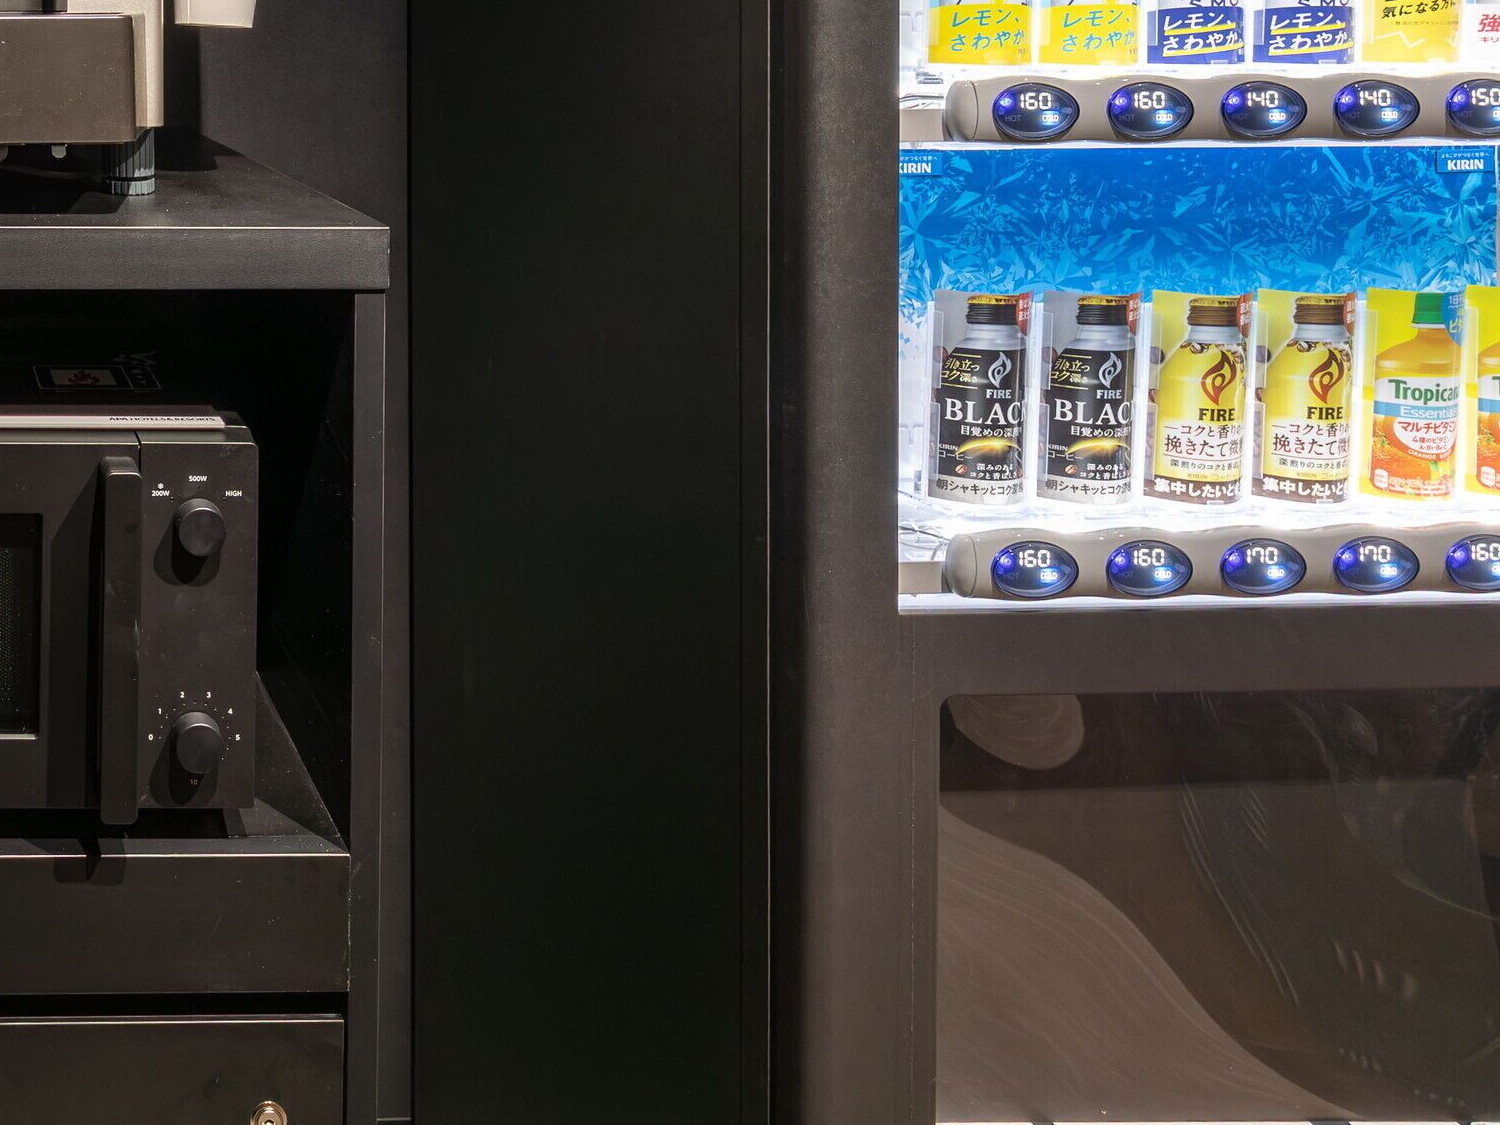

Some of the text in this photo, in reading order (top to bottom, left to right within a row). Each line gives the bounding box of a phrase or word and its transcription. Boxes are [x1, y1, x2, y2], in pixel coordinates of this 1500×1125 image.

[951, 9, 1020, 28] レモン、
[1063, 10, 1130, 28] レモン、
[1163, 12, 1233, 31] レモン、
[1270, 12, 1343, 31] レモン、
[1020, 92, 1052, 110] 160
[1133, 91, 1166, 109] 160
[1247, 90, 1279, 108] 140
[1359, 89, 1391, 107] 140
[1004, 114, 1021, 122] HOT
[1042, 114, 1059, 122] COLD
[1118, 114, 1135, 122] HOT
[1155, 113, 1173, 122] COLD
[1269, 112, 1286, 121] COLD
[1381, 111, 1398, 120] COLD
[1447, 159, 1484, 171] KIRIN
[944, 357, 980, 372] 引き立つ
[1054, 358, 1090, 372] 引き立つ
[985, 389, 1012, 399] FIRE
[1096, 389, 1122, 399] FIRE
[1198, 407, 1236, 422] FIRE
[1307, 406, 1343, 420] FIRE
[939, 443, 959, 451] KIRIN
[1048, 443, 1068, 451] KIRIN
[939, 450, 974, 461] コーヒー
[1048, 450, 1084, 461] コーヒー
[976, 463, 1014, 471] 深みのある
[1086, 463, 1123, 471] 深みのある
[1018, 549, 1051, 568] 160
[1133, 549, 1165, 567] 160
[1246, 546, 1278, 564] 170
[1359, 544, 1391, 563] 170
[1470, 543, 1500, 561] 160
[158, 707, 162, 715] 1
[228, 707, 233, 715] 4
